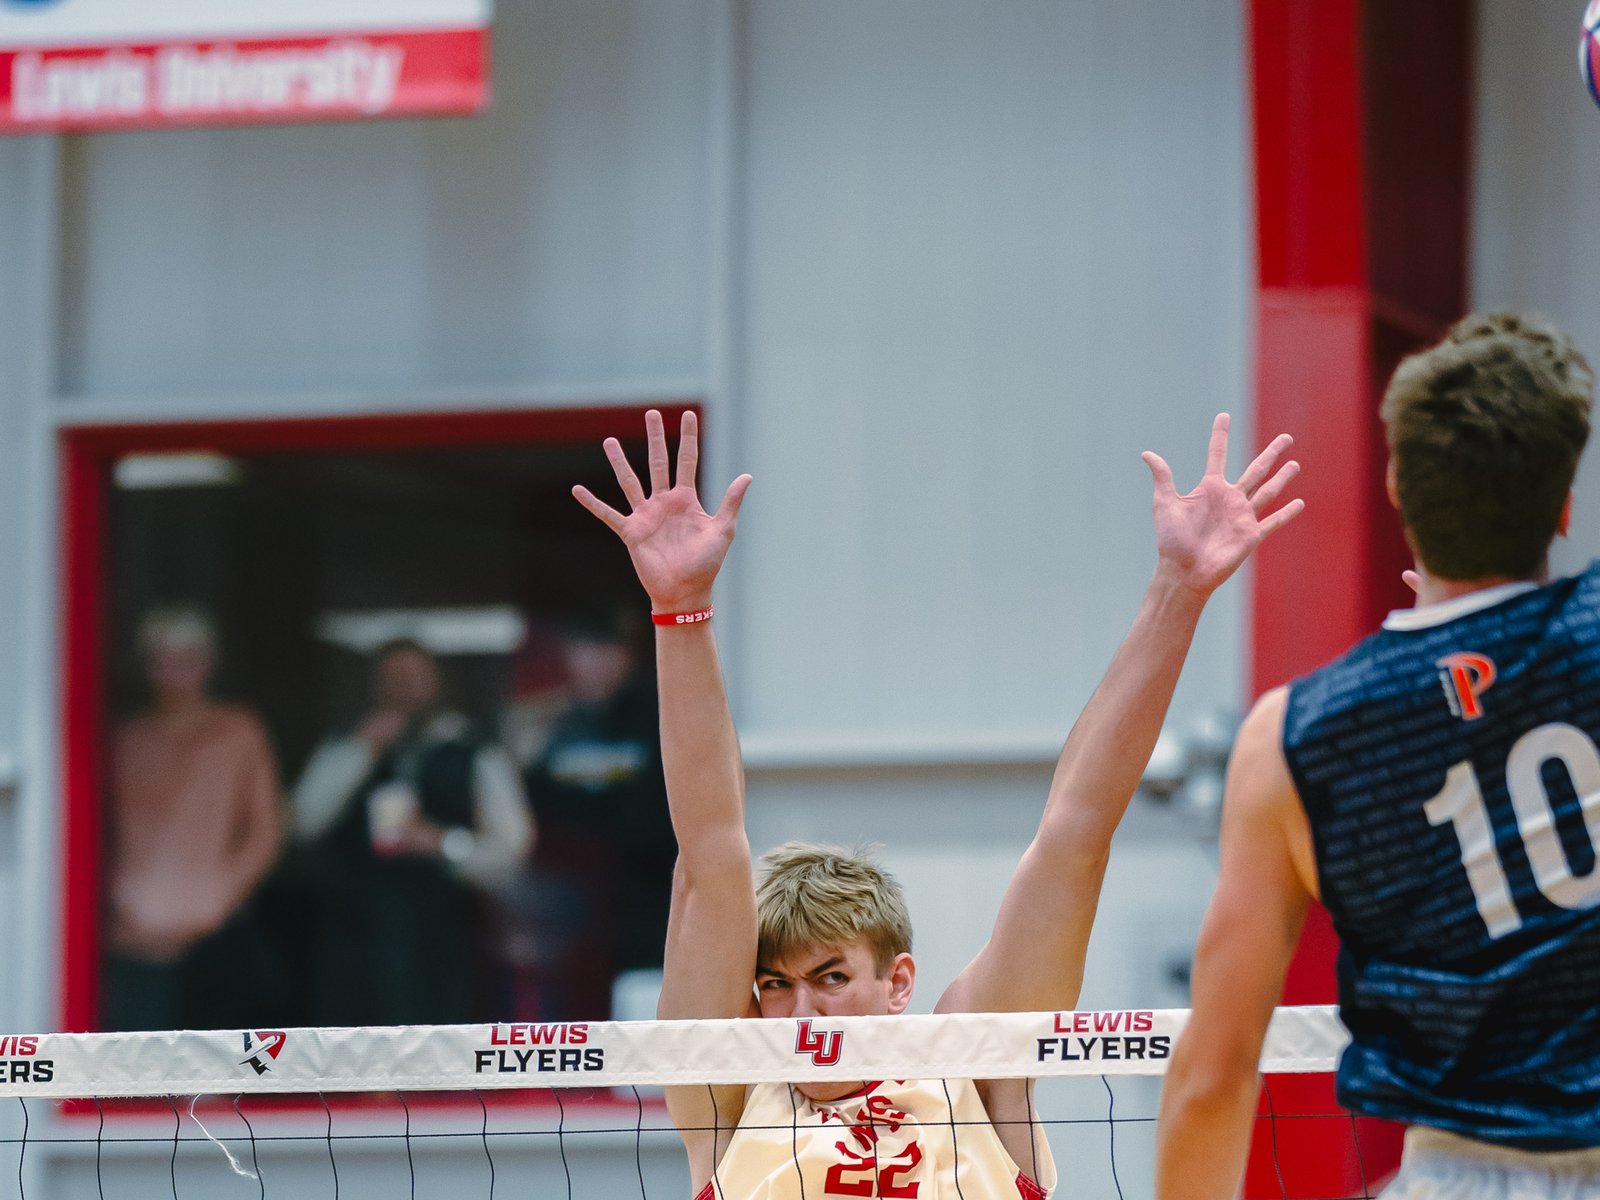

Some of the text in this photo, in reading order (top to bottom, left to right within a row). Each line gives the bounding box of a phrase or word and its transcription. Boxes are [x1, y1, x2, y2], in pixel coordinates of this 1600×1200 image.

[1422, 722, 1600, 940] 10
[490, 1024, 589, 1046] LEWIS
[1053, 1011, 1153, 1034] LEWIS
[795, 1019, 844, 1066] LU
[1037, 1036, 1171, 1061] FLYERS
[474, 1048, 604, 1073] FLYERS
[823, 1140, 922, 1199] 22
